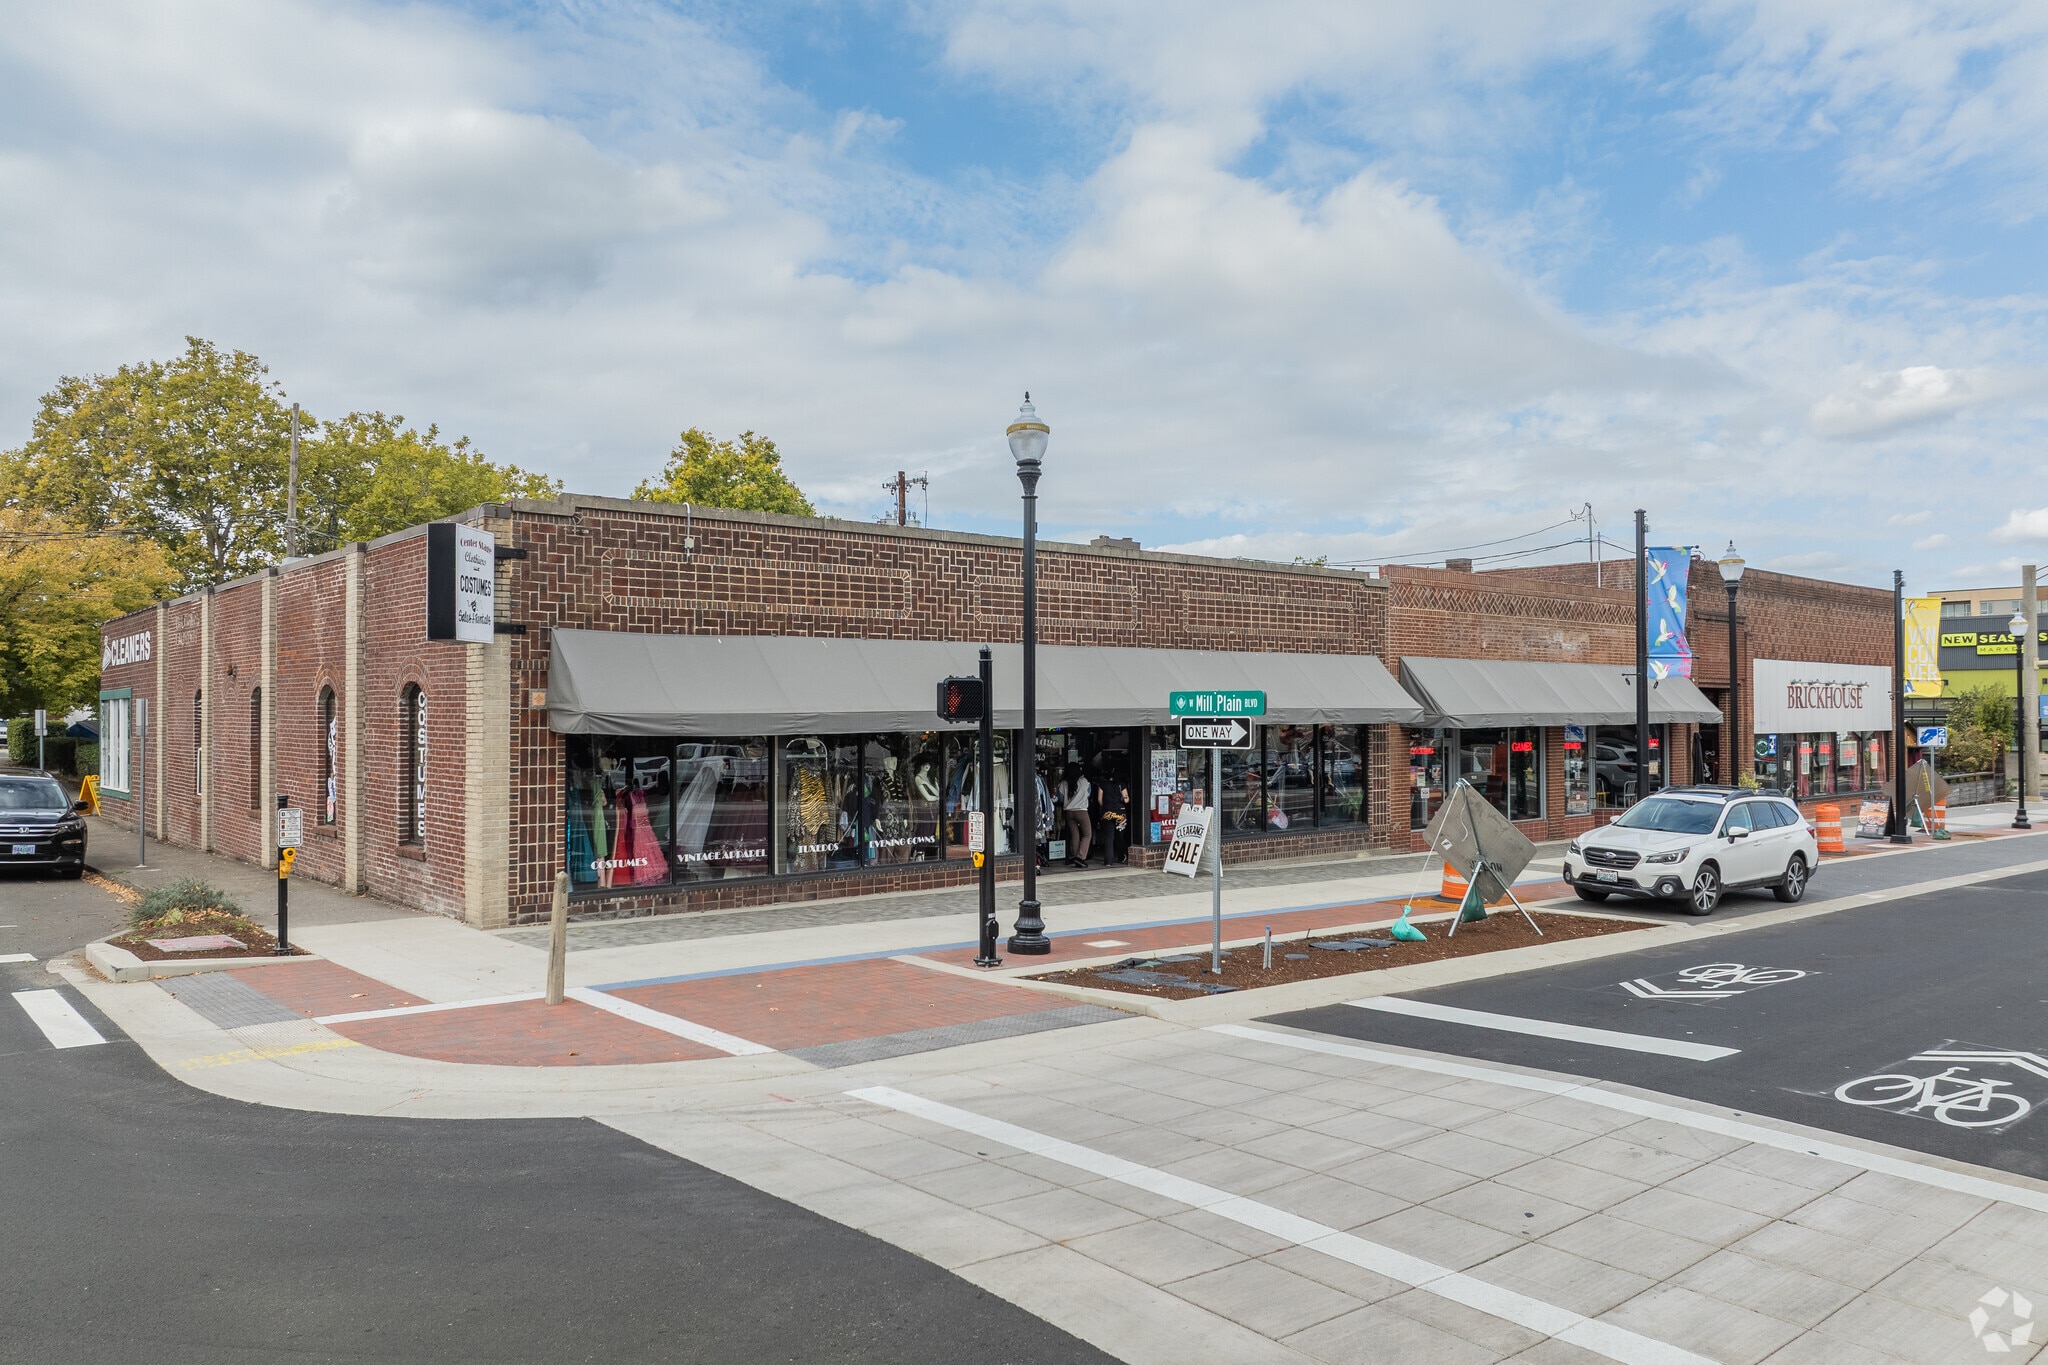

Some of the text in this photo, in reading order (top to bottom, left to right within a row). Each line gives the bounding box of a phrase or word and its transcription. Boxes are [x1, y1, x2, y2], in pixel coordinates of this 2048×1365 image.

[460, 538, 493, 553] Center Stage
[460, 575, 491, 597] COSTUMES
[1944, 635, 1973, 644] NEW
[111, 631, 150, 666] CLEANERS
[1189, 694, 1258, 712] W Mill Plain BLVD
[1787, 685, 1863, 709] BRICKHOUSE
[1188, 726, 1232, 738] ONE WAY
[1512, 742, 1532, 752] GAMES
[417, 691, 427, 837] COSTUMES
[1176, 826, 1204, 839] CLEARANCE
[798, 842, 838, 853] TUXEDOS
[869, 836, 935, 848] EVENING GOWNS
[677, 849, 767, 863] VINTAGE APPAREL
[1170, 840, 1200, 864] SALE
[590, 858, 648, 870] COSTUMES
